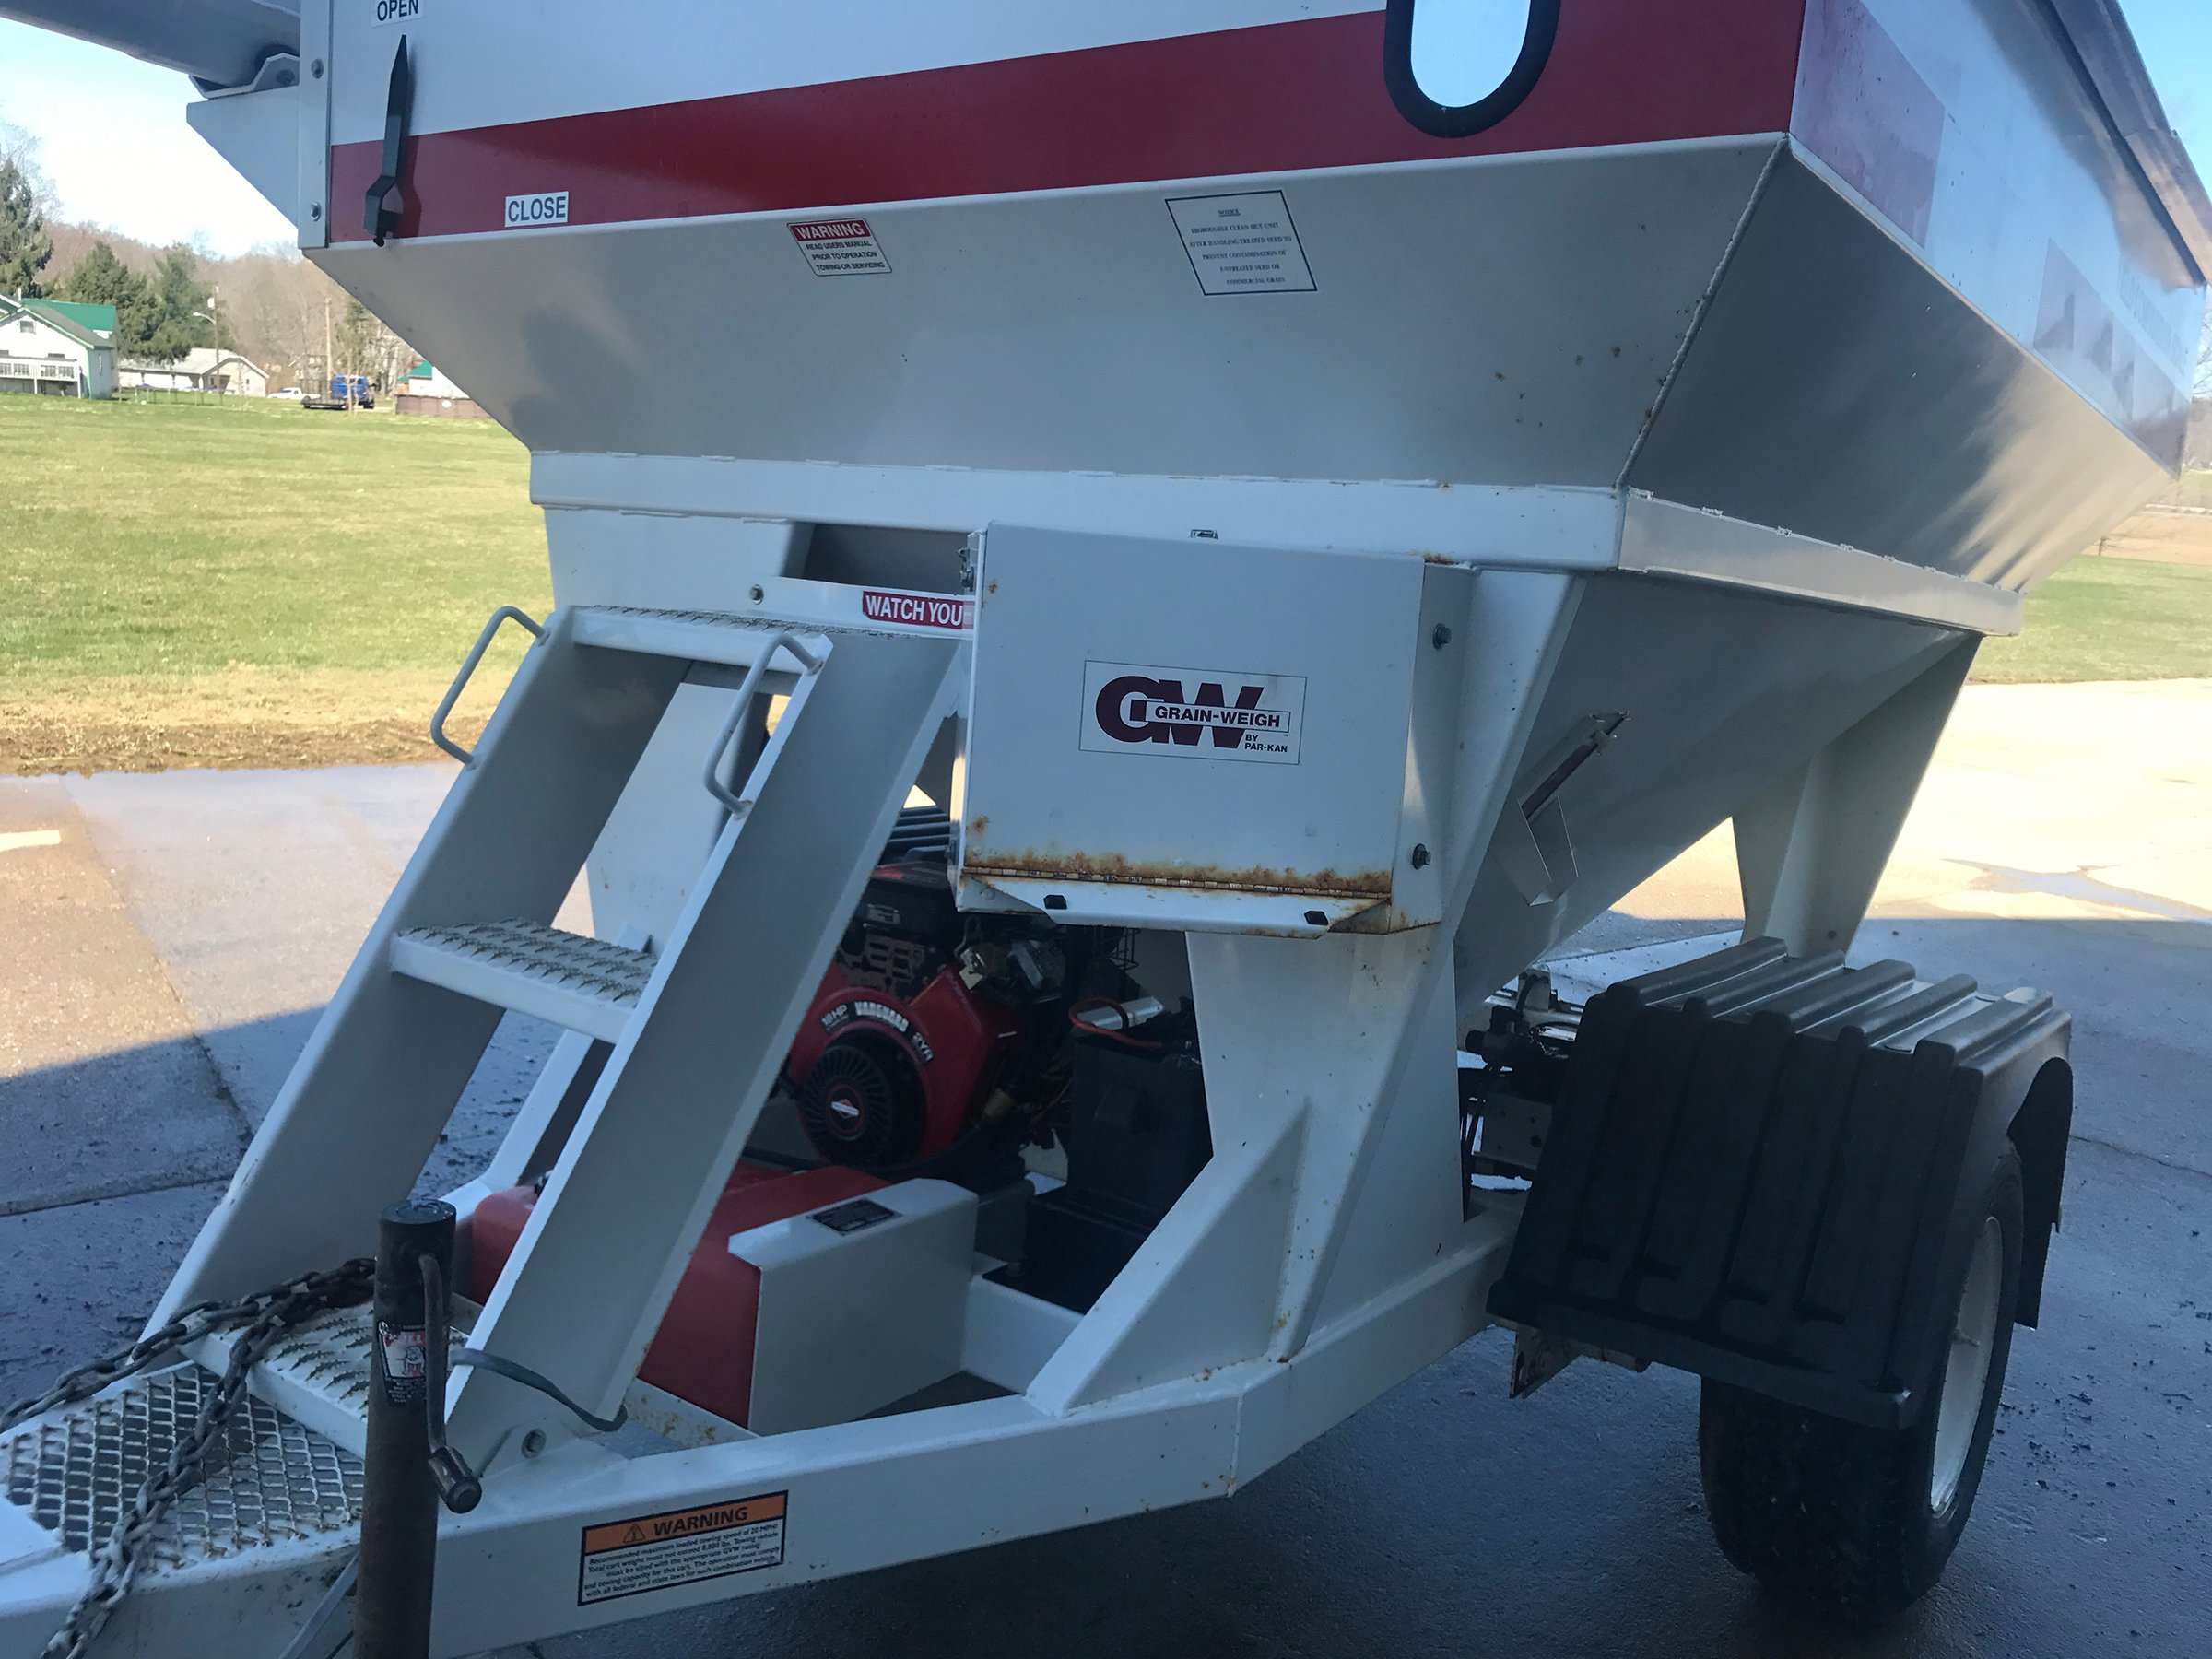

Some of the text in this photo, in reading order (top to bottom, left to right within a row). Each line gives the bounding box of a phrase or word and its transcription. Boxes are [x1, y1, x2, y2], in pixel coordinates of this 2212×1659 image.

[377, 0, 418, 21] OPEN
[508, 196, 567, 222] CLOSE
[795, 223, 865, 240] WARNING
[841, 251, 878, 259] OPERATION
[1229, 250, 1277, 258] CONTAMINATION
[865, 595, 925, 621] WATCH
[1154, 706, 1280, 727] GRAIN-WEIGH
[1245, 734, 1258, 742] BY
[1244, 742, 1288, 753] PAR-KAN
[653, 1507, 747, 1536] WARNING
[590, 1550, 640, 1564] Recommended
[621, 1558, 645, 1566] weight
